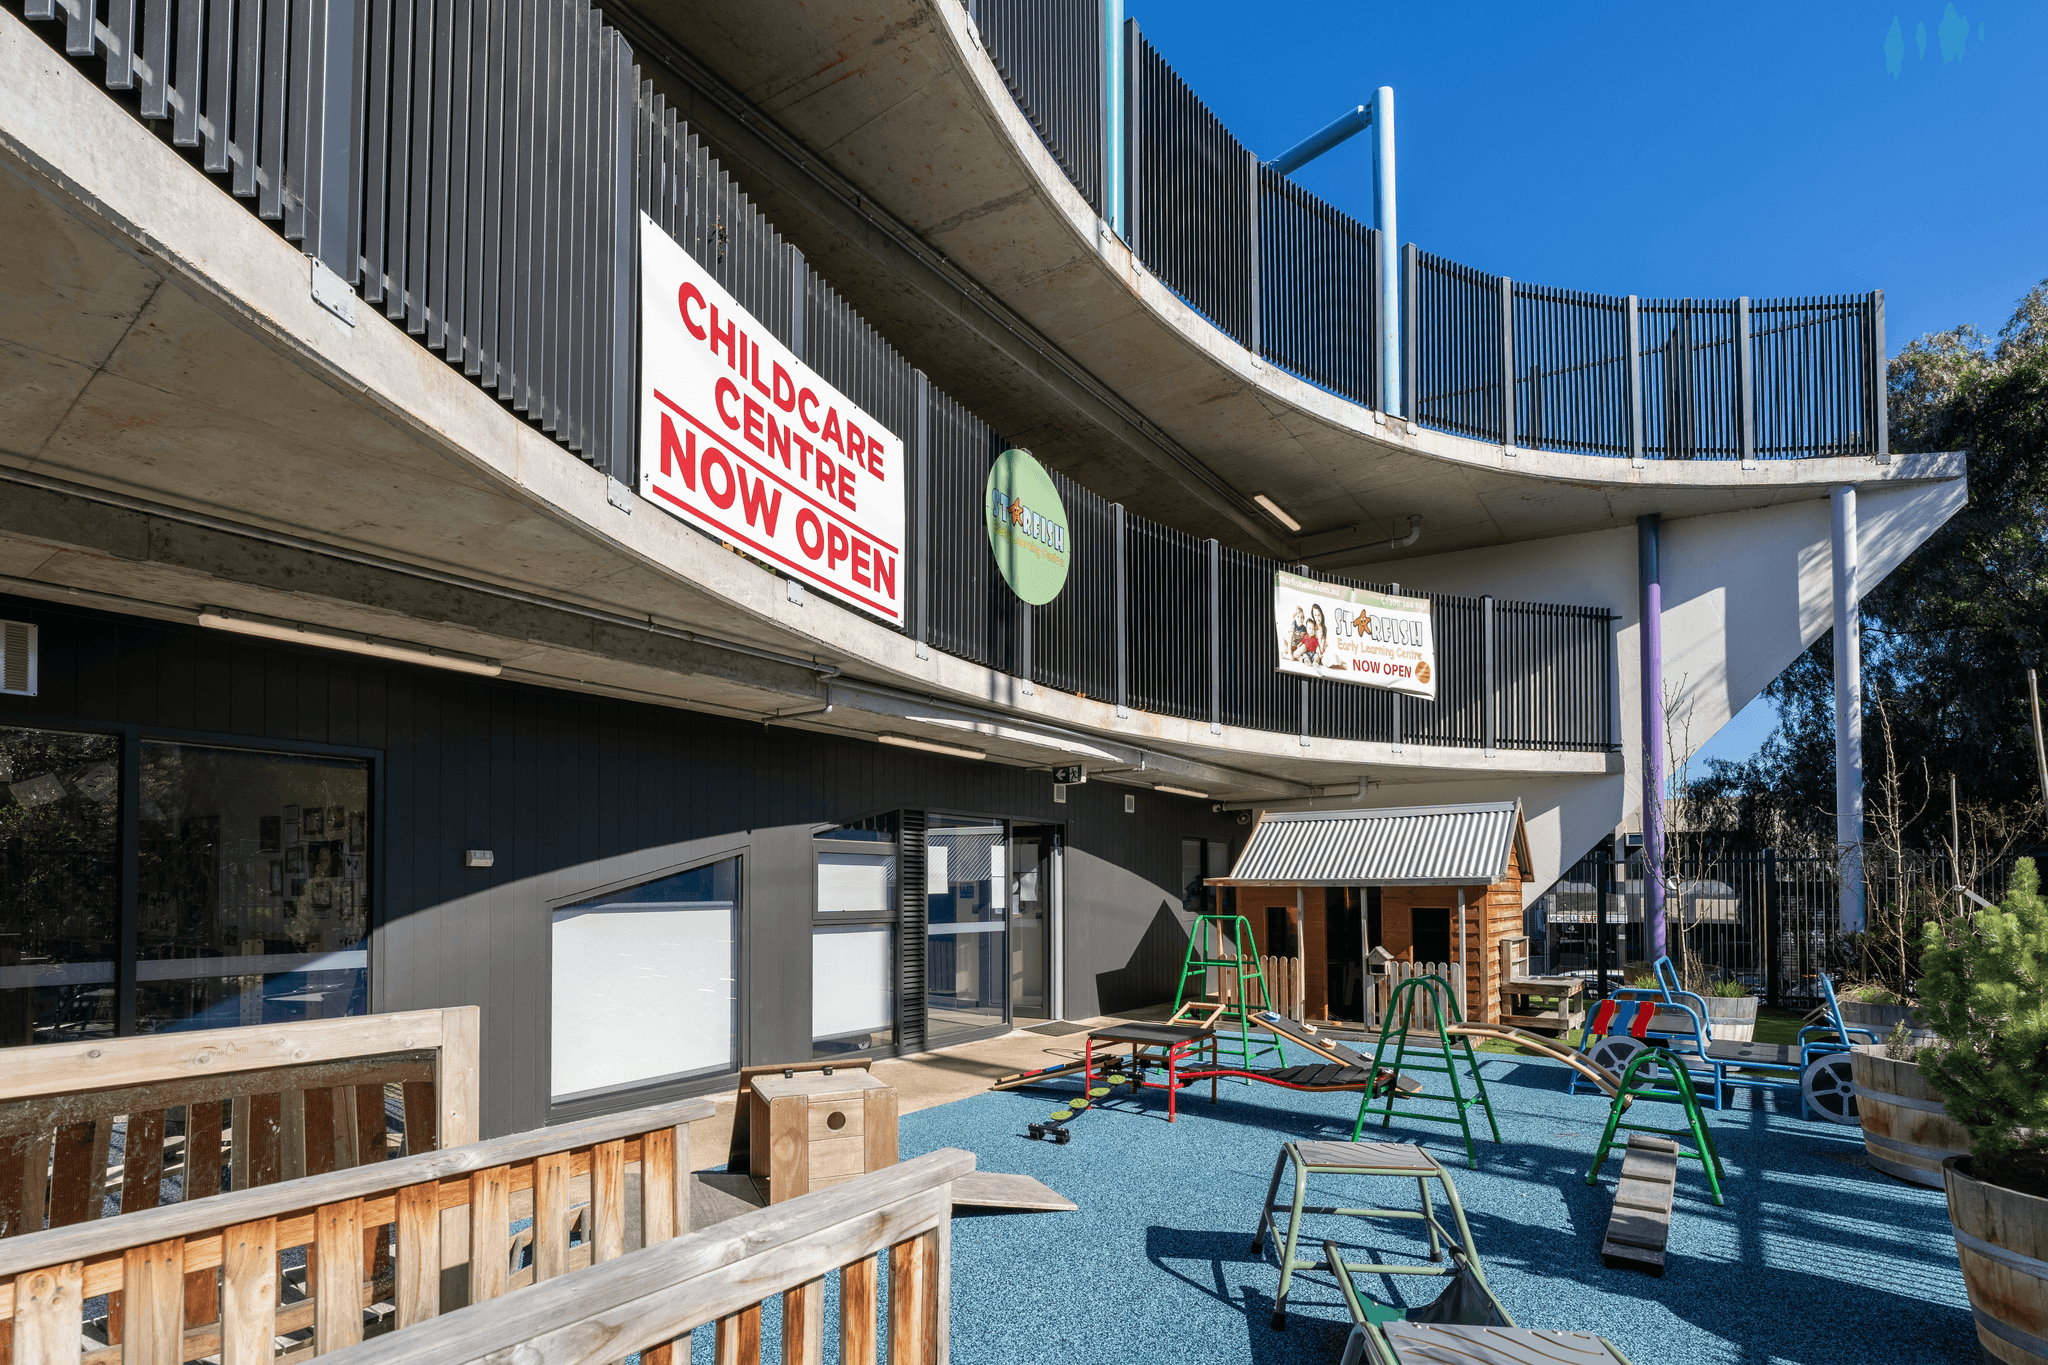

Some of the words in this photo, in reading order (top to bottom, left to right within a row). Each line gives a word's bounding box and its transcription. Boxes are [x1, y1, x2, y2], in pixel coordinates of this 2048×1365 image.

[678, 281, 885, 482] CHILDCARE
[714, 376, 857, 512] CENTRE
[660, 411, 782, 538] NOW
[795, 507, 896, 600] OPEN
[993, 520, 1012, 544] Early
[1012, 531, 1041, 559] Learning
[1042, 548, 1064, 567] Centre
[1279, 575, 1340, 596] starfishelc.com.au
[1386, 597, 1401, 607] 1300
[1402, 600, 1414, 608] 168
[1337, 637, 1359, 655] Early
[1361, 642, 1395, 660] Learning
[1396, 647, 1422, 661] Centre
[1352, 658, 1381, 674] NOW
[1383, 663, 1412, 679] OPEN
